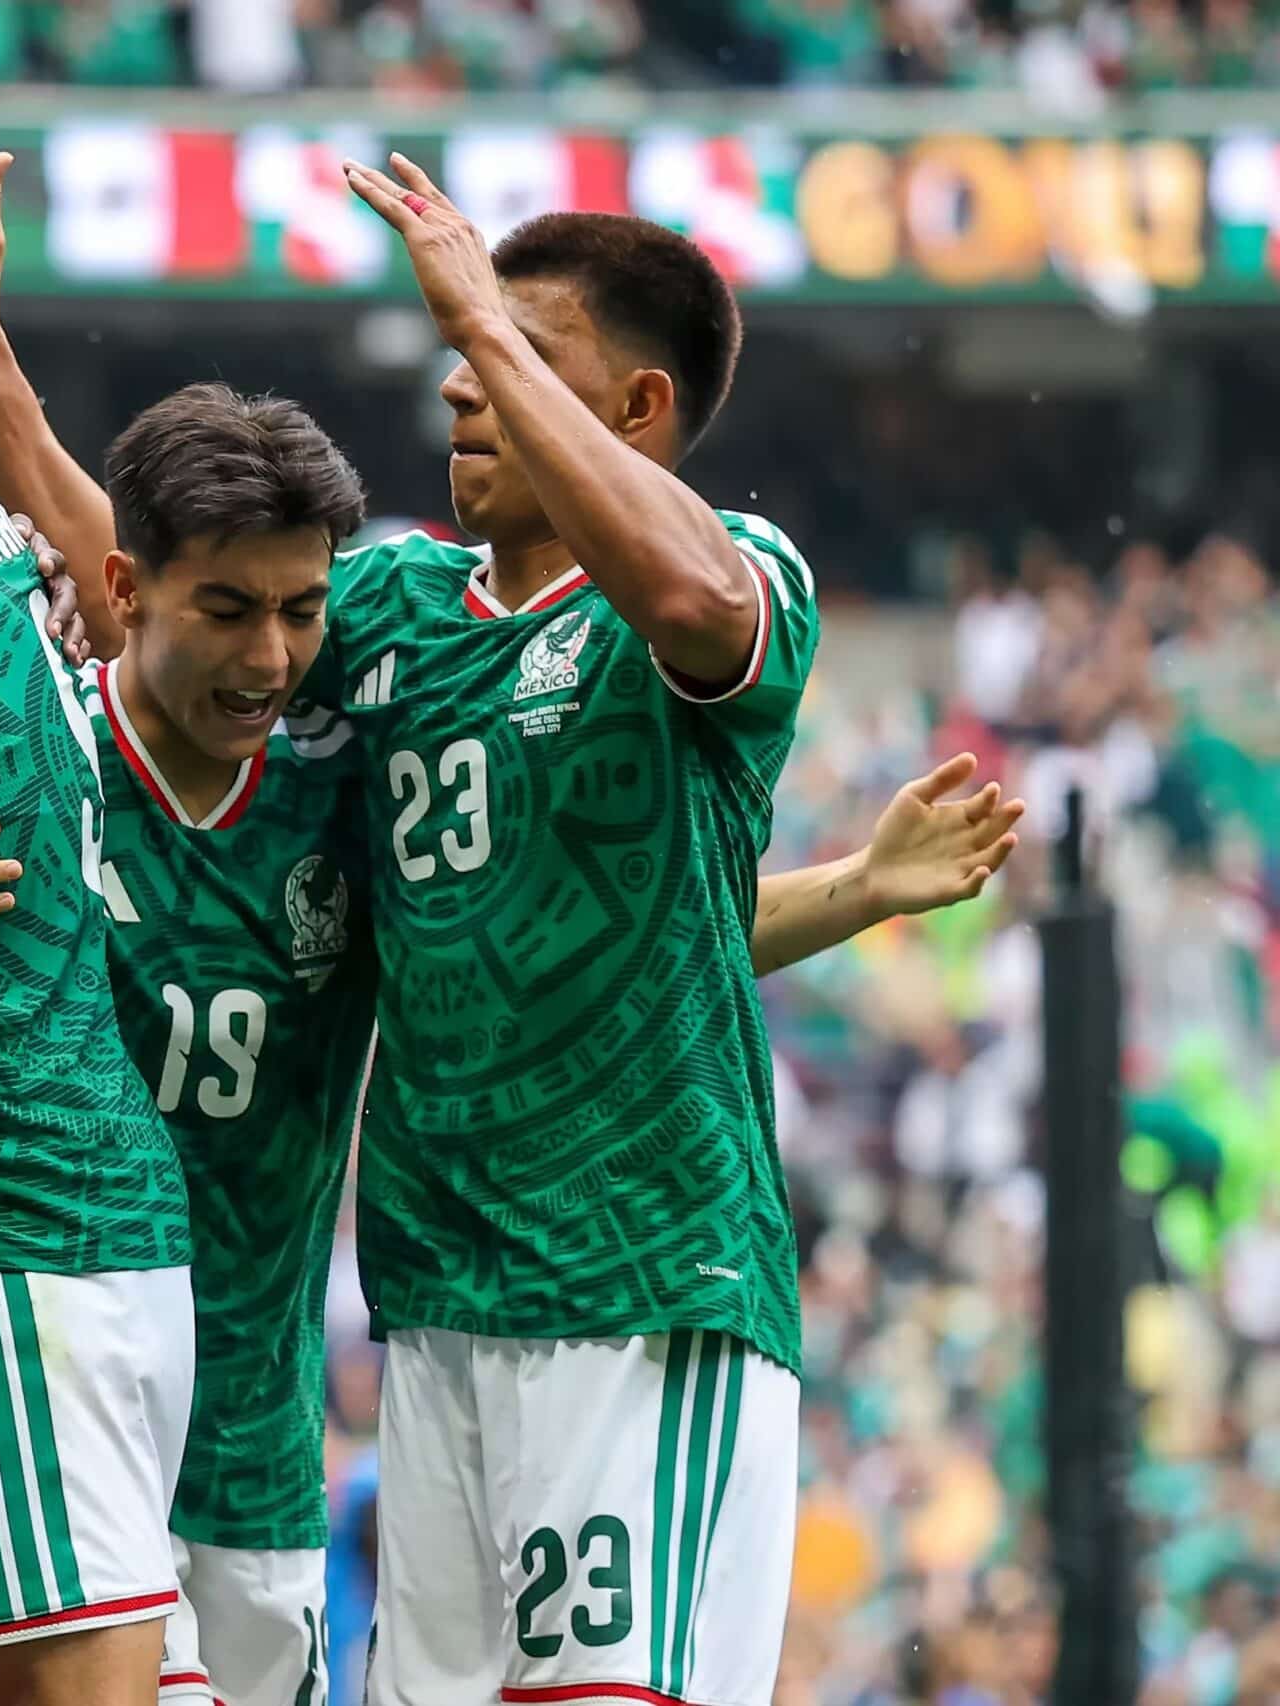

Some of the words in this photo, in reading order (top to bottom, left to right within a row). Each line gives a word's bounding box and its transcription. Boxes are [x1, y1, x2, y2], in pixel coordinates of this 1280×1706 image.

[388, 738, 492, 882] 23
[157, 983, 266, 1118] 19
[516, 1514, 633, 1658] 23
